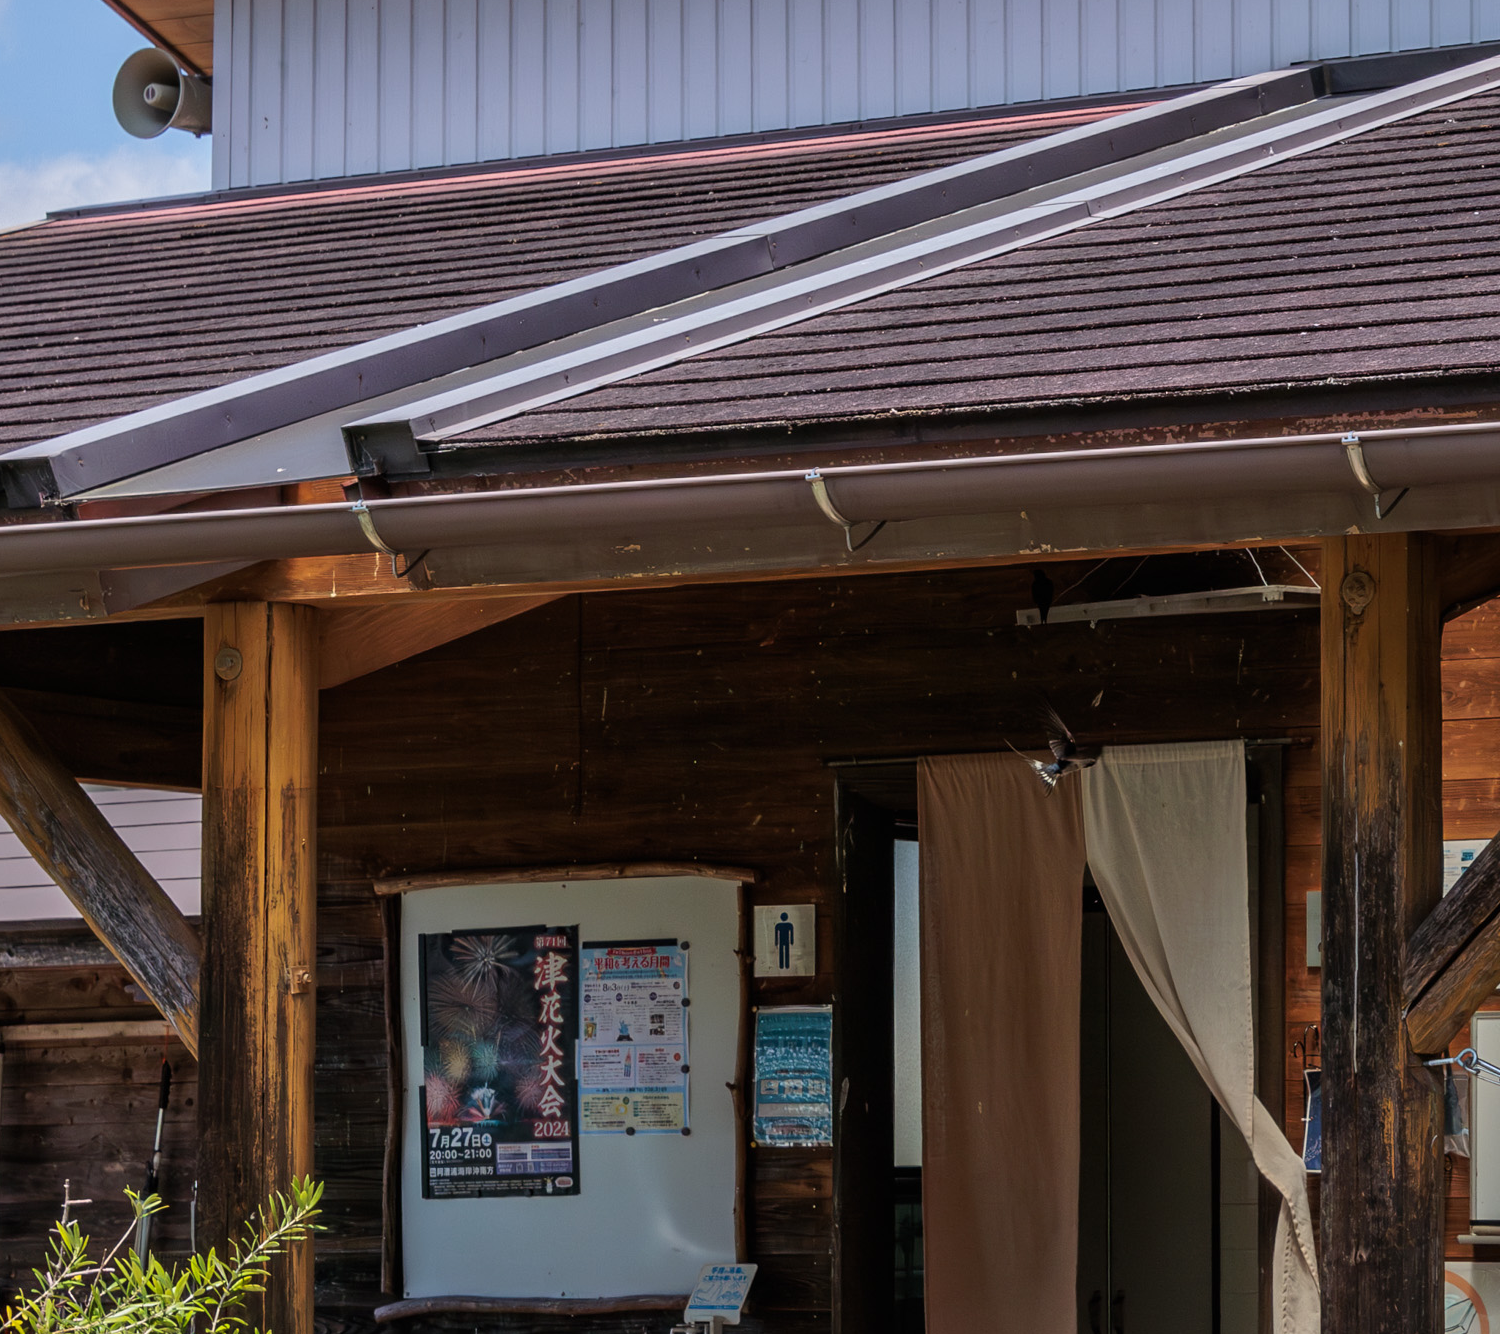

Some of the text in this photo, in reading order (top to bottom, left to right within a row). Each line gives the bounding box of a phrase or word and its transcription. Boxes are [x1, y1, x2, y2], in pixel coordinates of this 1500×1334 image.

[534, 952, 568, 1118] 津花火大会
[534, 1121, 569, 1137] 2024
